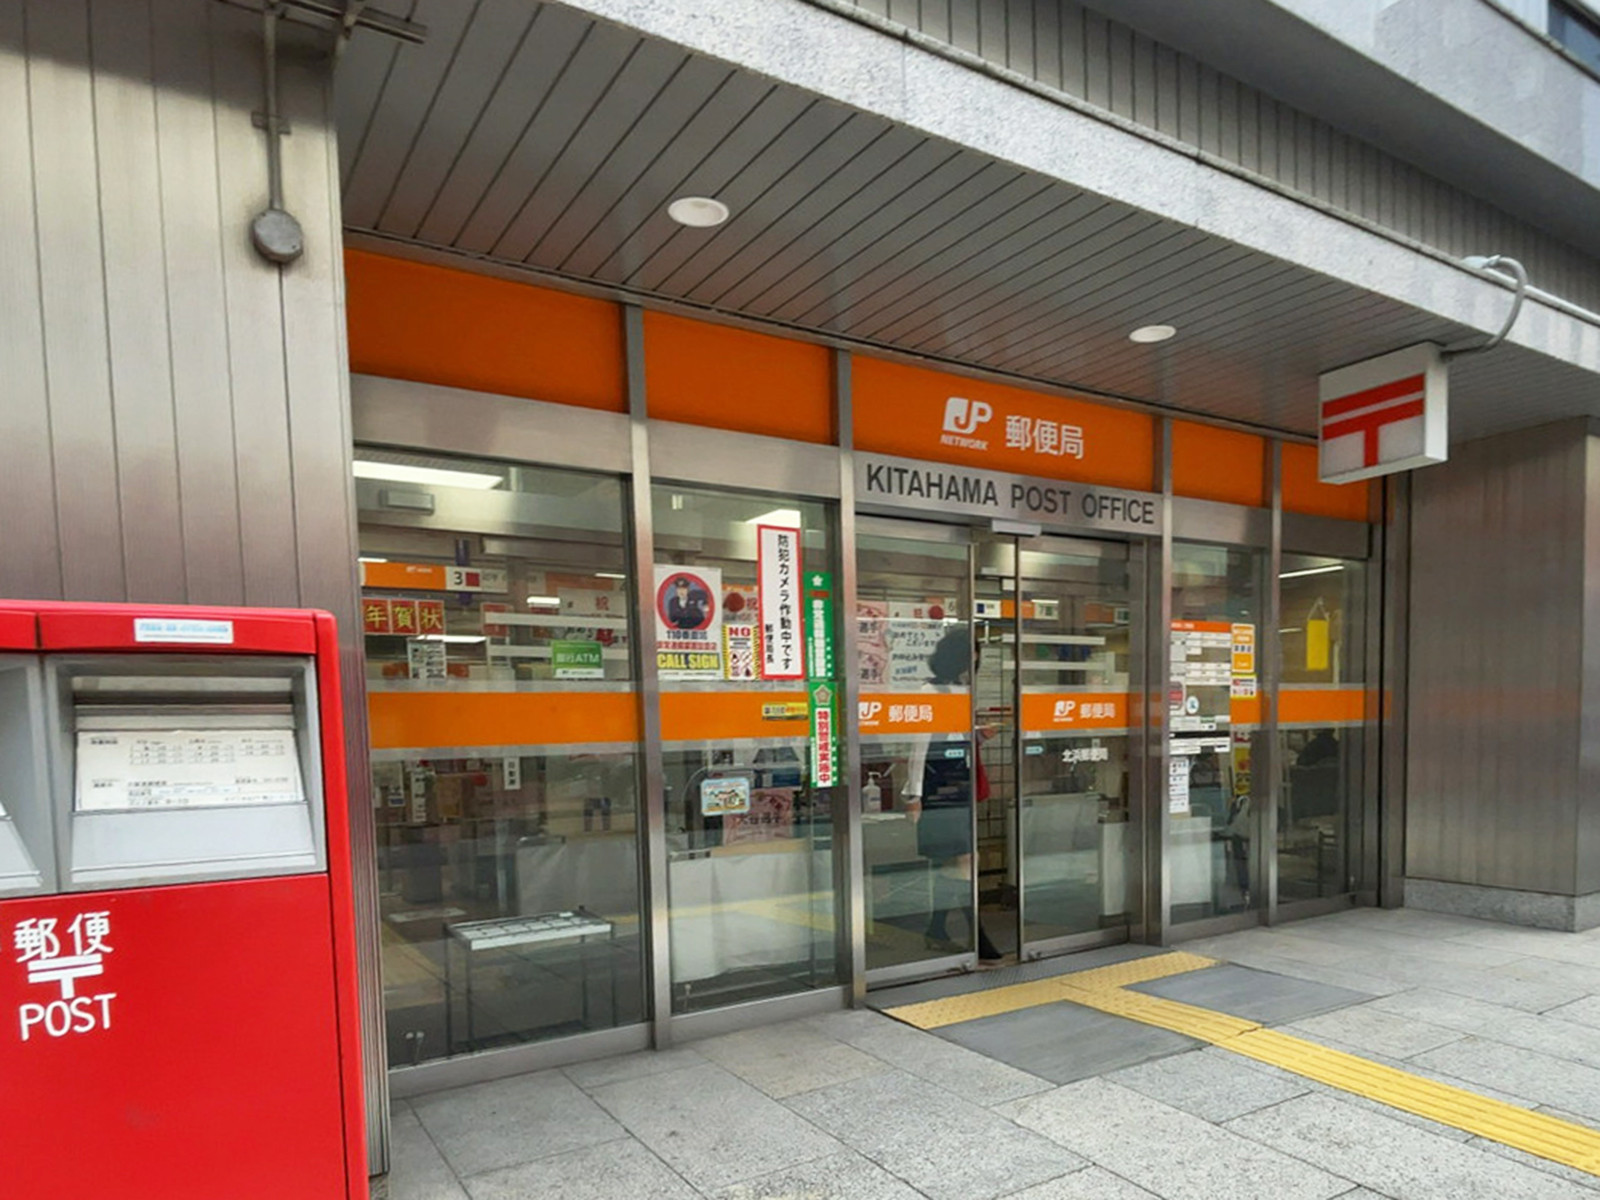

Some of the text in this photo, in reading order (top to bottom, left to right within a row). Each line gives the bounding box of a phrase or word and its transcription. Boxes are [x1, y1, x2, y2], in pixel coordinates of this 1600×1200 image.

[942, 397, 992, 434] JP
[940, 434, 988, 450] NETWORK
[1006, 415, 1084, 459] 郵便局
[866, 464, 1155, 525] KITAHAMA POST OFFICE
[453, 571, 463, 586] 3
[777, 534, 792, 670] 防犯カメラ作動中です
[366, 604, 443, 630] 年賀状
[728, 627, 751, 637] NO
[657, 653, 719, 669] CALL SIGN
[888, 704, 934, 723] 郵便局
[1080, 702, 1116, 719] 郵便局
[13, 910, 114, 963] 郵便
[19, 993, 117, 1042] POST
